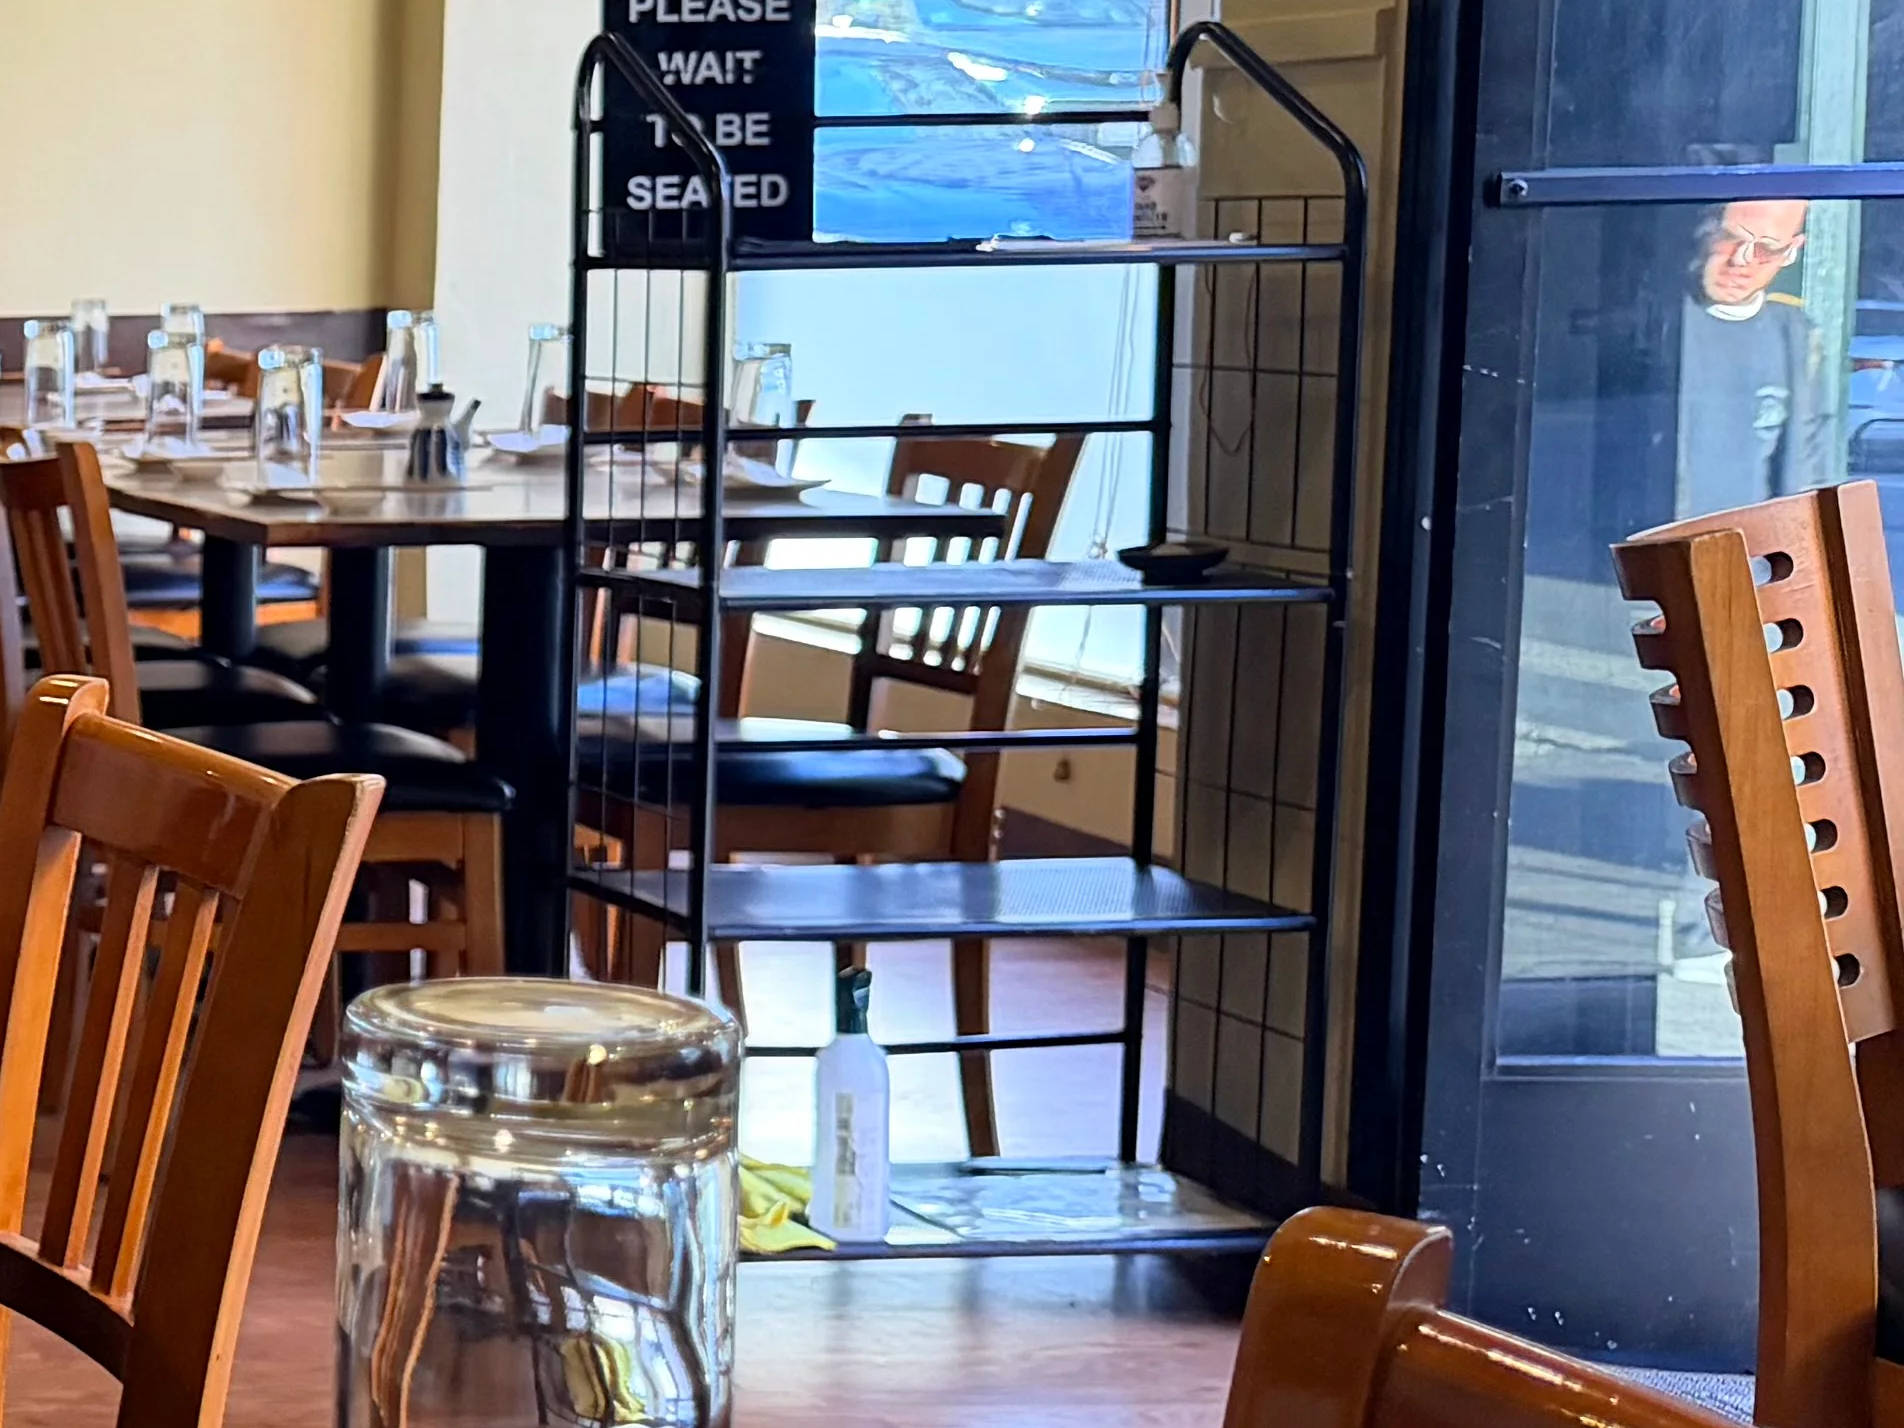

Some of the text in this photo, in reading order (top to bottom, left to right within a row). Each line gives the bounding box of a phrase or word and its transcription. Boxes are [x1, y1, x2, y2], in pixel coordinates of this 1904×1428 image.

[657, 49, 763, 85] WAIT
[716, 112, 772, 147] BE
[626, 173, 790, 210] SEAED
